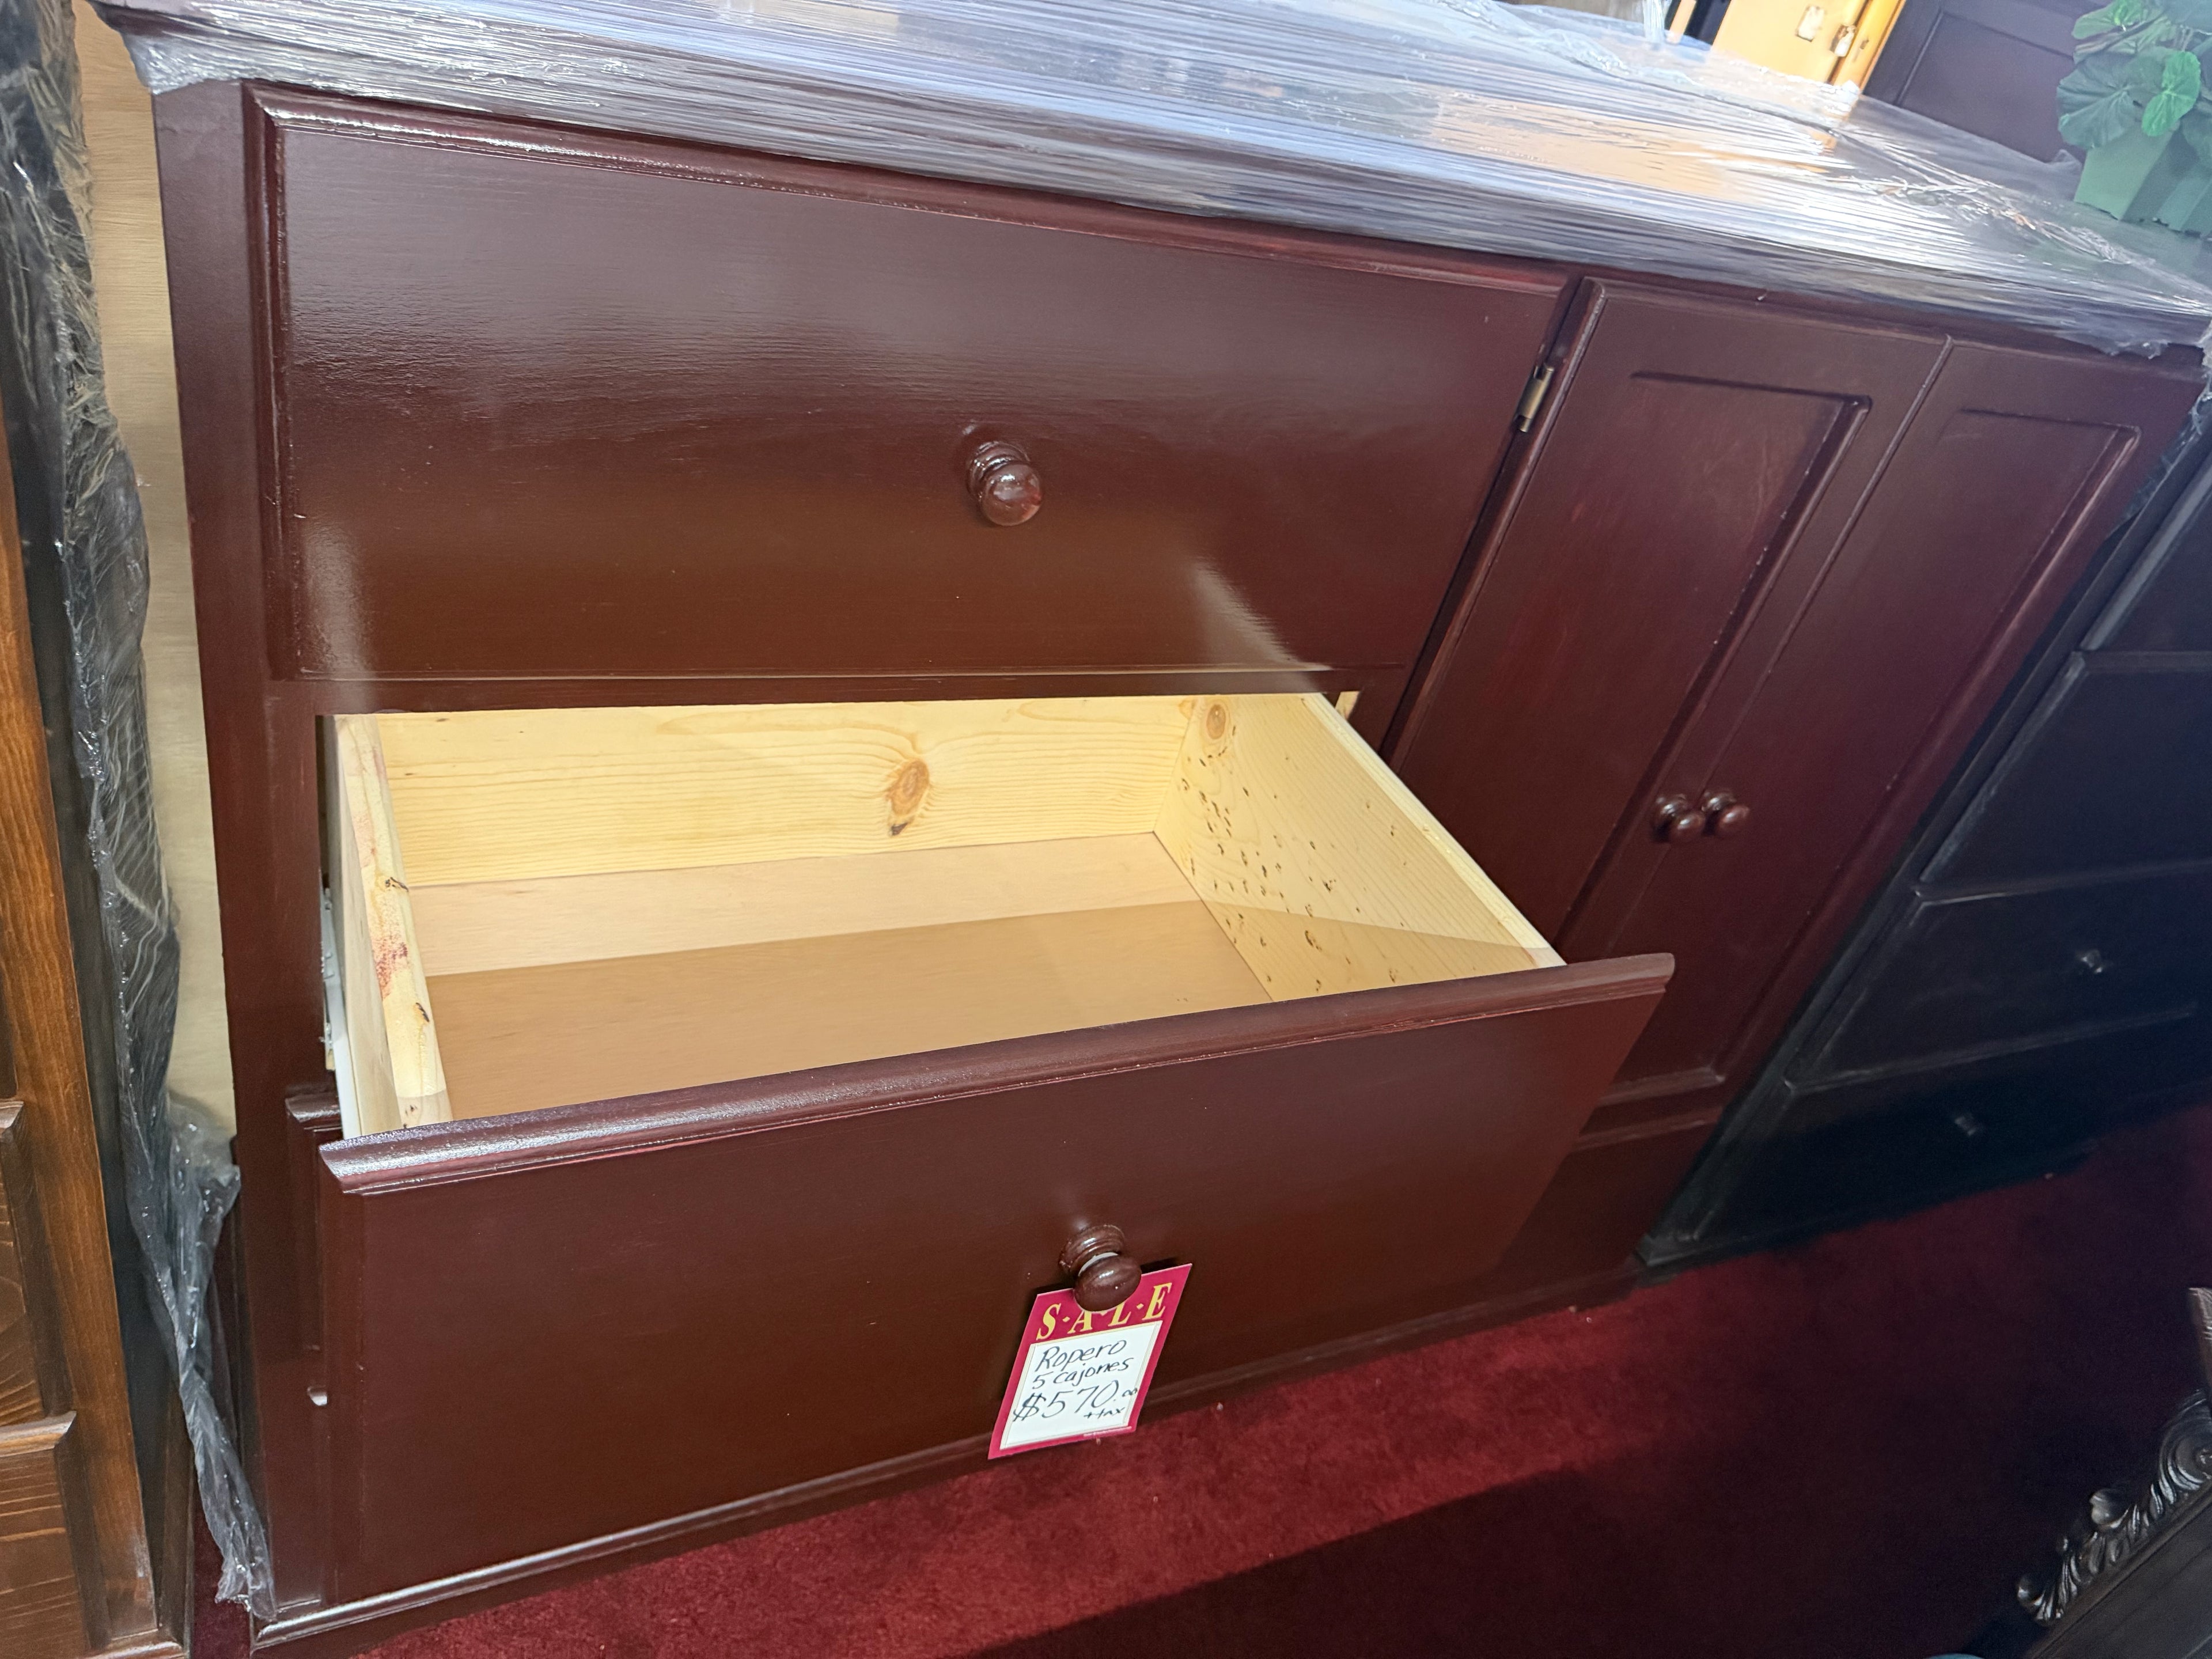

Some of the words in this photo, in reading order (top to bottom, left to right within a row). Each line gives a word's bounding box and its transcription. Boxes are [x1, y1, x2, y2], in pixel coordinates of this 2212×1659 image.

[1035, 1339, 1127, 1373] Ropero
[1032, 1371, 1054, 1390] 5
[1052, 1357, 1135, 1387] cajones
